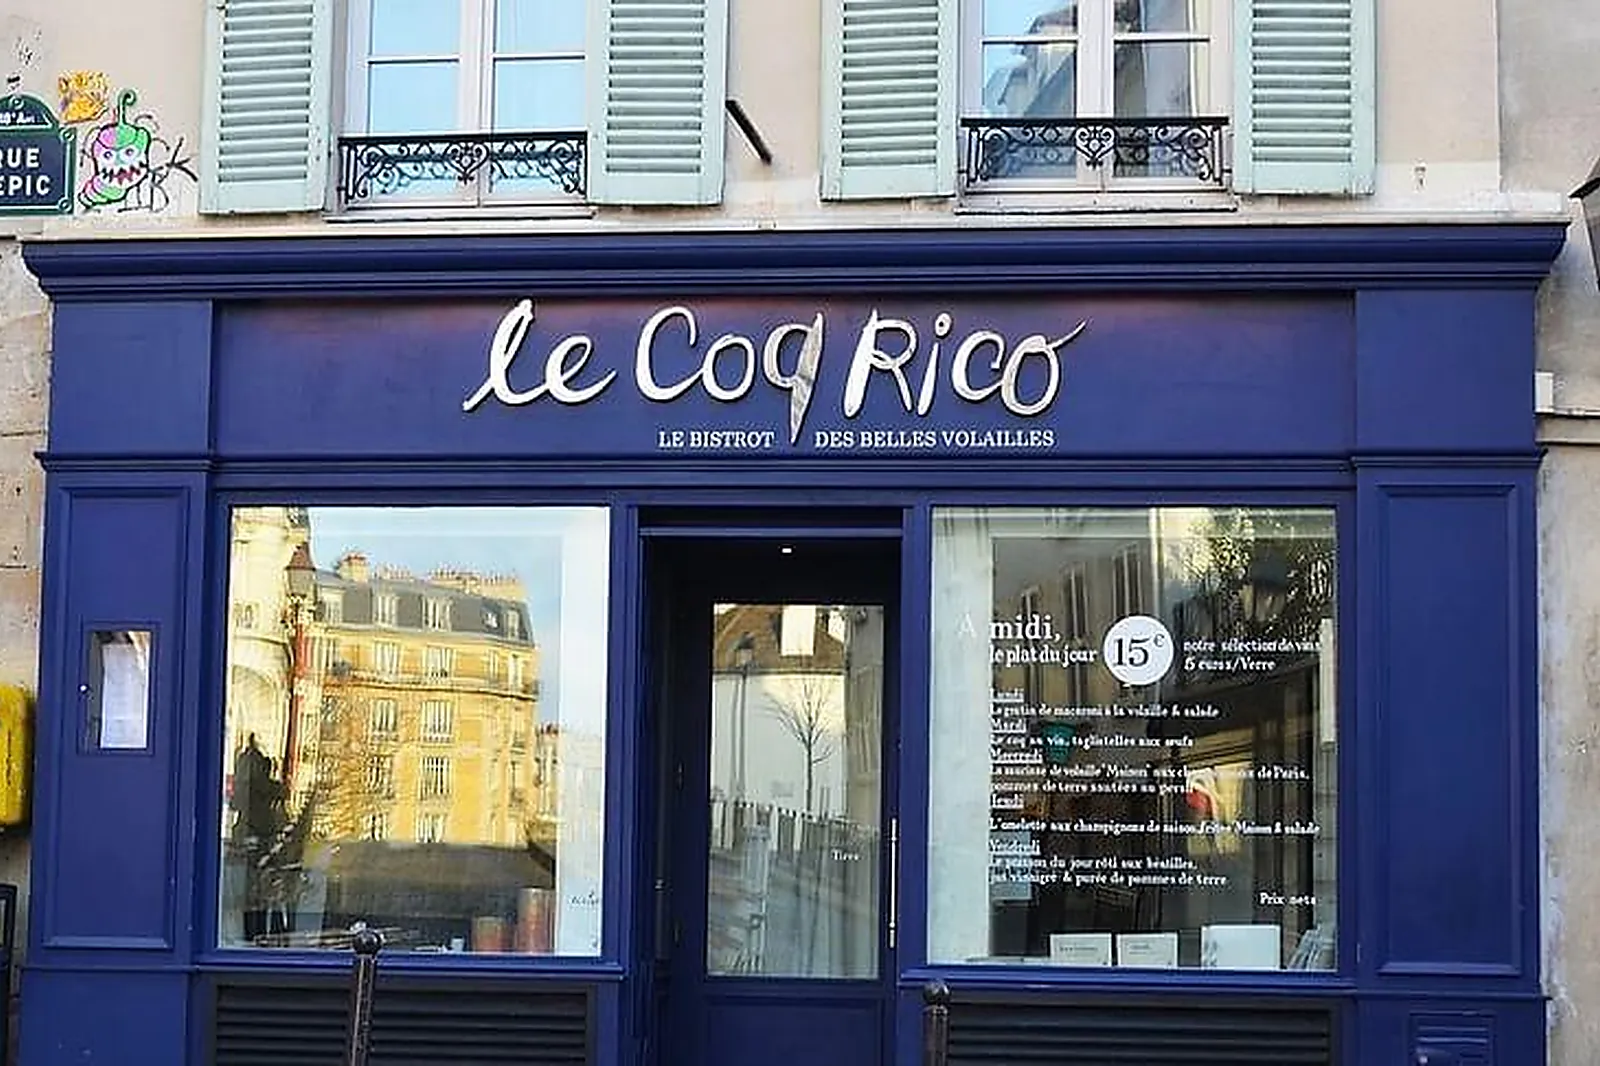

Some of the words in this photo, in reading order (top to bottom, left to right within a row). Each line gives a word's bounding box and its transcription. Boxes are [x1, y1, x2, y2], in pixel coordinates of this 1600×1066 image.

[0, 148, 40, 168] UE
[463, 299, 617, 412] le
[635, 305, 823, 444] Coq
[843, 308, 1086, 418] Rico
[659, 431, 684, 448] LE
[690, 431, 775, 448] BISTROT
[815, 431, 854, 448] DES
[860, 431, 936, 448] BELLES
[942, 431, 1055, 448] VOLAILLES
[990, 613, 1061, 642] midi,
[990, 645, 1004, 662] le
[1006, 645, 1038, 667] plat
[1039, 645, 1060, 662] du
[1062, 645, 1098, 667] jour
